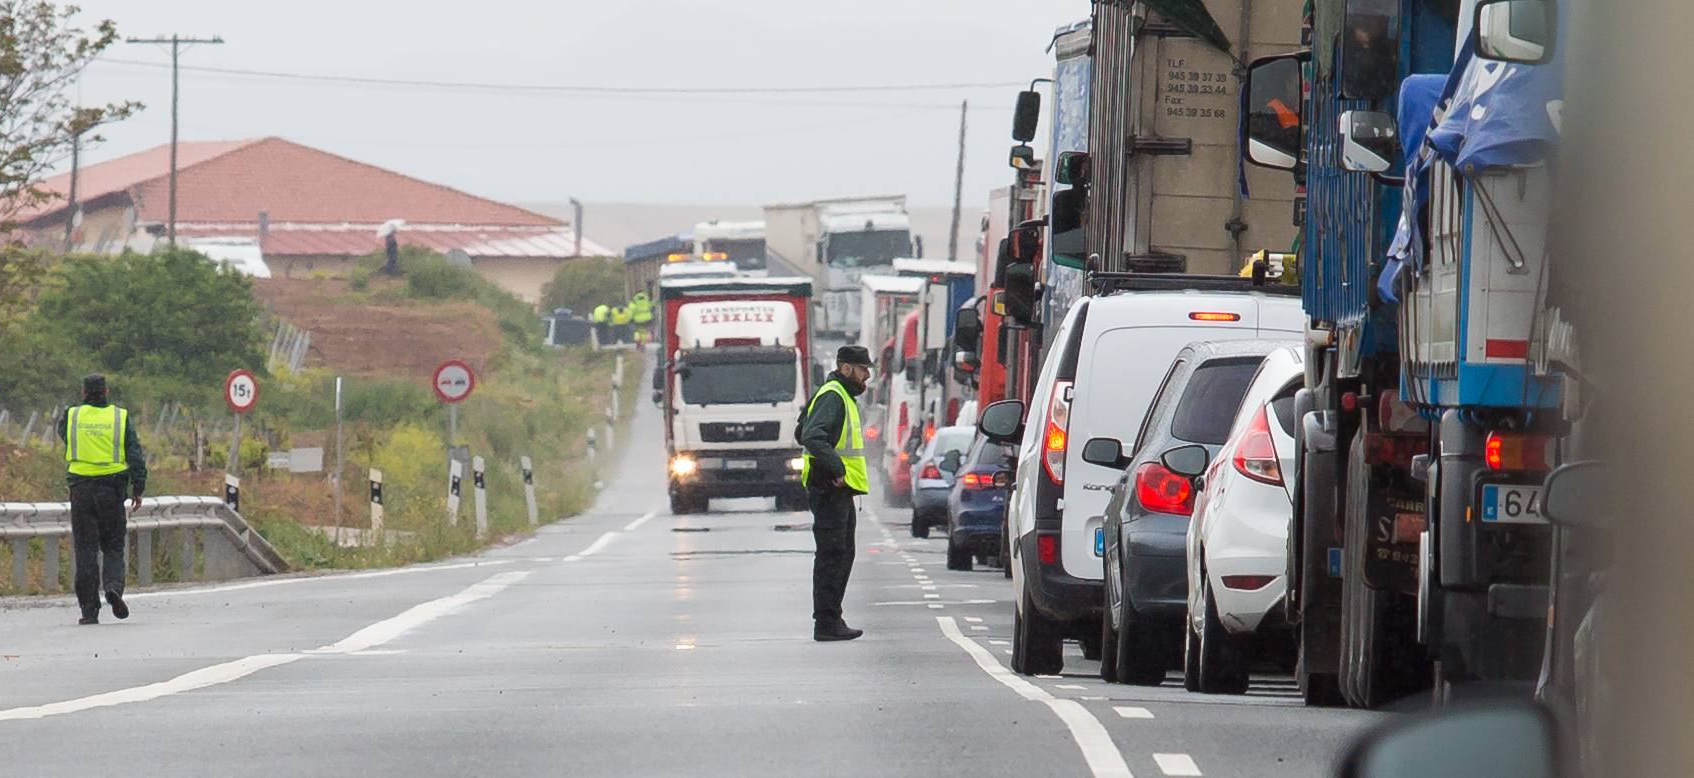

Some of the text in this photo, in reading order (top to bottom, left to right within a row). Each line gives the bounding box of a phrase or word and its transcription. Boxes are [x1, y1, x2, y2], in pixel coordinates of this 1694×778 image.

[1168, 71, 1185, 80] 945
[1202, 73, 1213, 81] 37
[1168, 83, 1185, 92] 945
[1167, 107, 1183, 116] 945
[1200, 109, 1212, 117] 35
[1214, 109, 1225, 118] 68
[1386, 497, 1426, 512] CARR
[1504, 489, 1540, 518] 64
